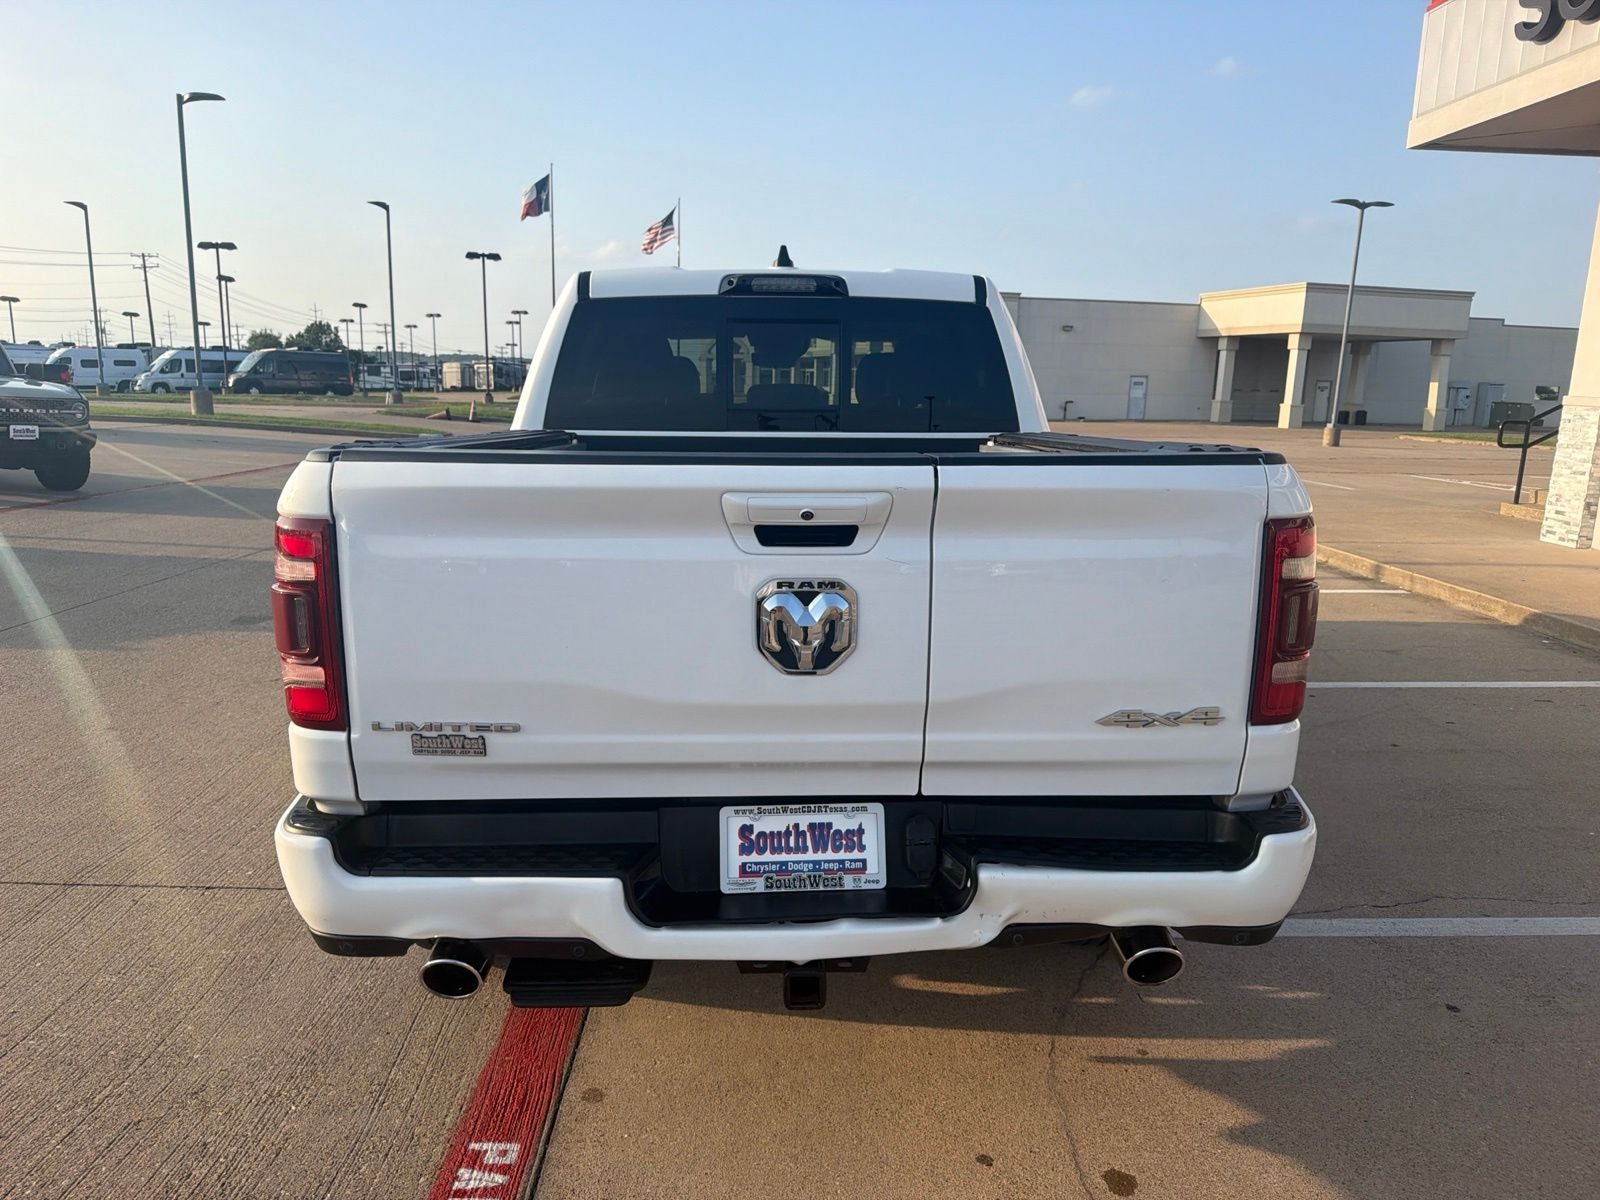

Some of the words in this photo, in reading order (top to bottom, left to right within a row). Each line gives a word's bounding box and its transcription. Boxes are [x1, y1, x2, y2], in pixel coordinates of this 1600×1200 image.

[776, 581, 837, 590] RAM
[371, 721, 521, 733] LIMITED
[411, 734, 485, 749] SouthWest
[733, 804, 868, 816] www.SouthWestCDJRTexas.com
[738, 821, 866, 856] SouthWest
[745, 863, 780, 873] Chrysler
[788, 862, 814, 872] Dodge
[820, 861, 839, 870] Jeep
[845, 860, 863, 869] Ram
[764, 873, 845, 890] SouthWest
[448, 1142, 520, 1200] PA
